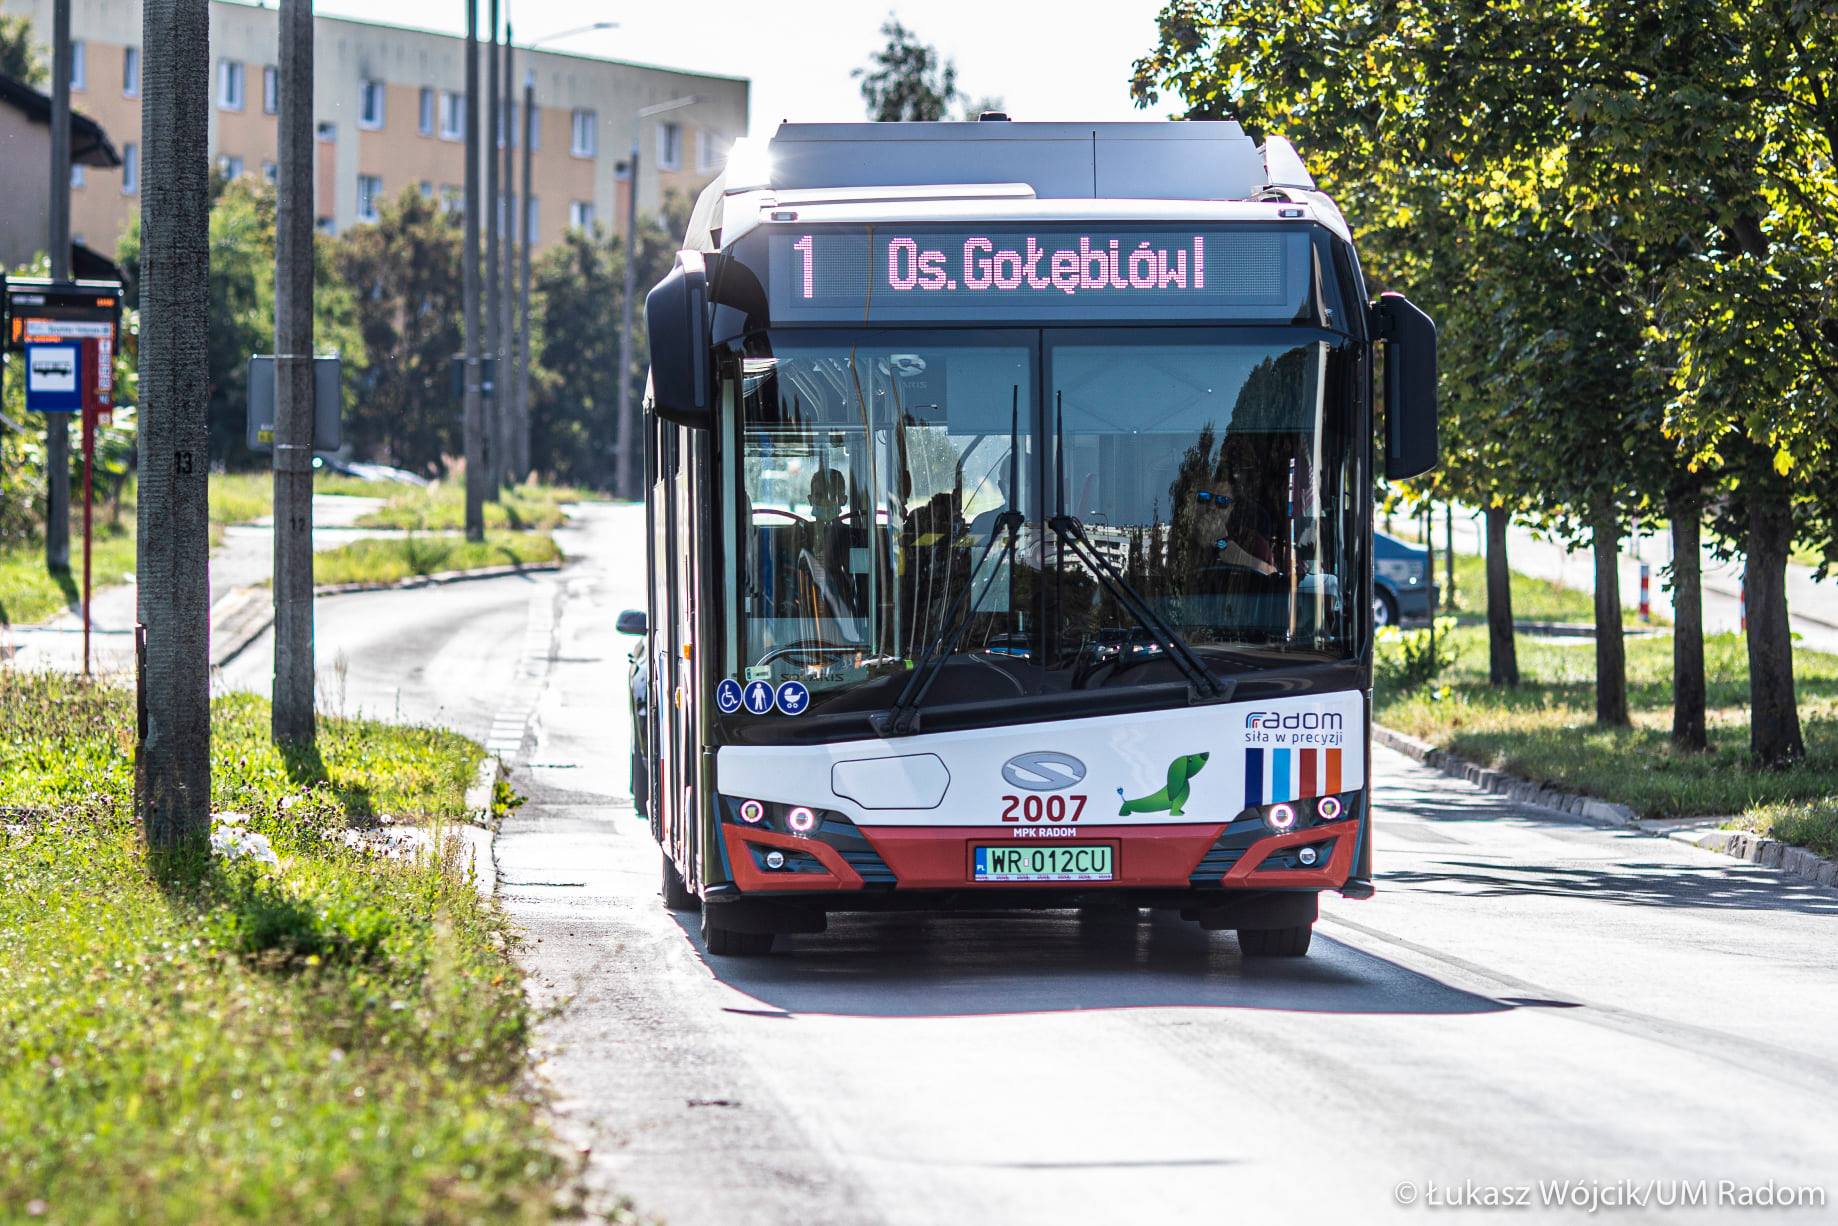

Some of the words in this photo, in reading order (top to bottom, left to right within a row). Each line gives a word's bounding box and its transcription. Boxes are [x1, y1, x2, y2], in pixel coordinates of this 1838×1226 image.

[793, 235, 813, 299] 1
[175, 451, 192, 474] 13
[1245, 711, 1343, 730] radom
[1245, 731, 1269, 742] siła
[1275, 733, 1286, 742] w
[1291, 731, 1343, 746] precyzji
[1001, 794, 1088, 823] 2007
[1013, 827, 1037, 838] MPK
[1038, 827, 1077, 838] RADOM
[991, 849, 1022, 873] WR
[1031, 849, 1106, 873] 012CU
